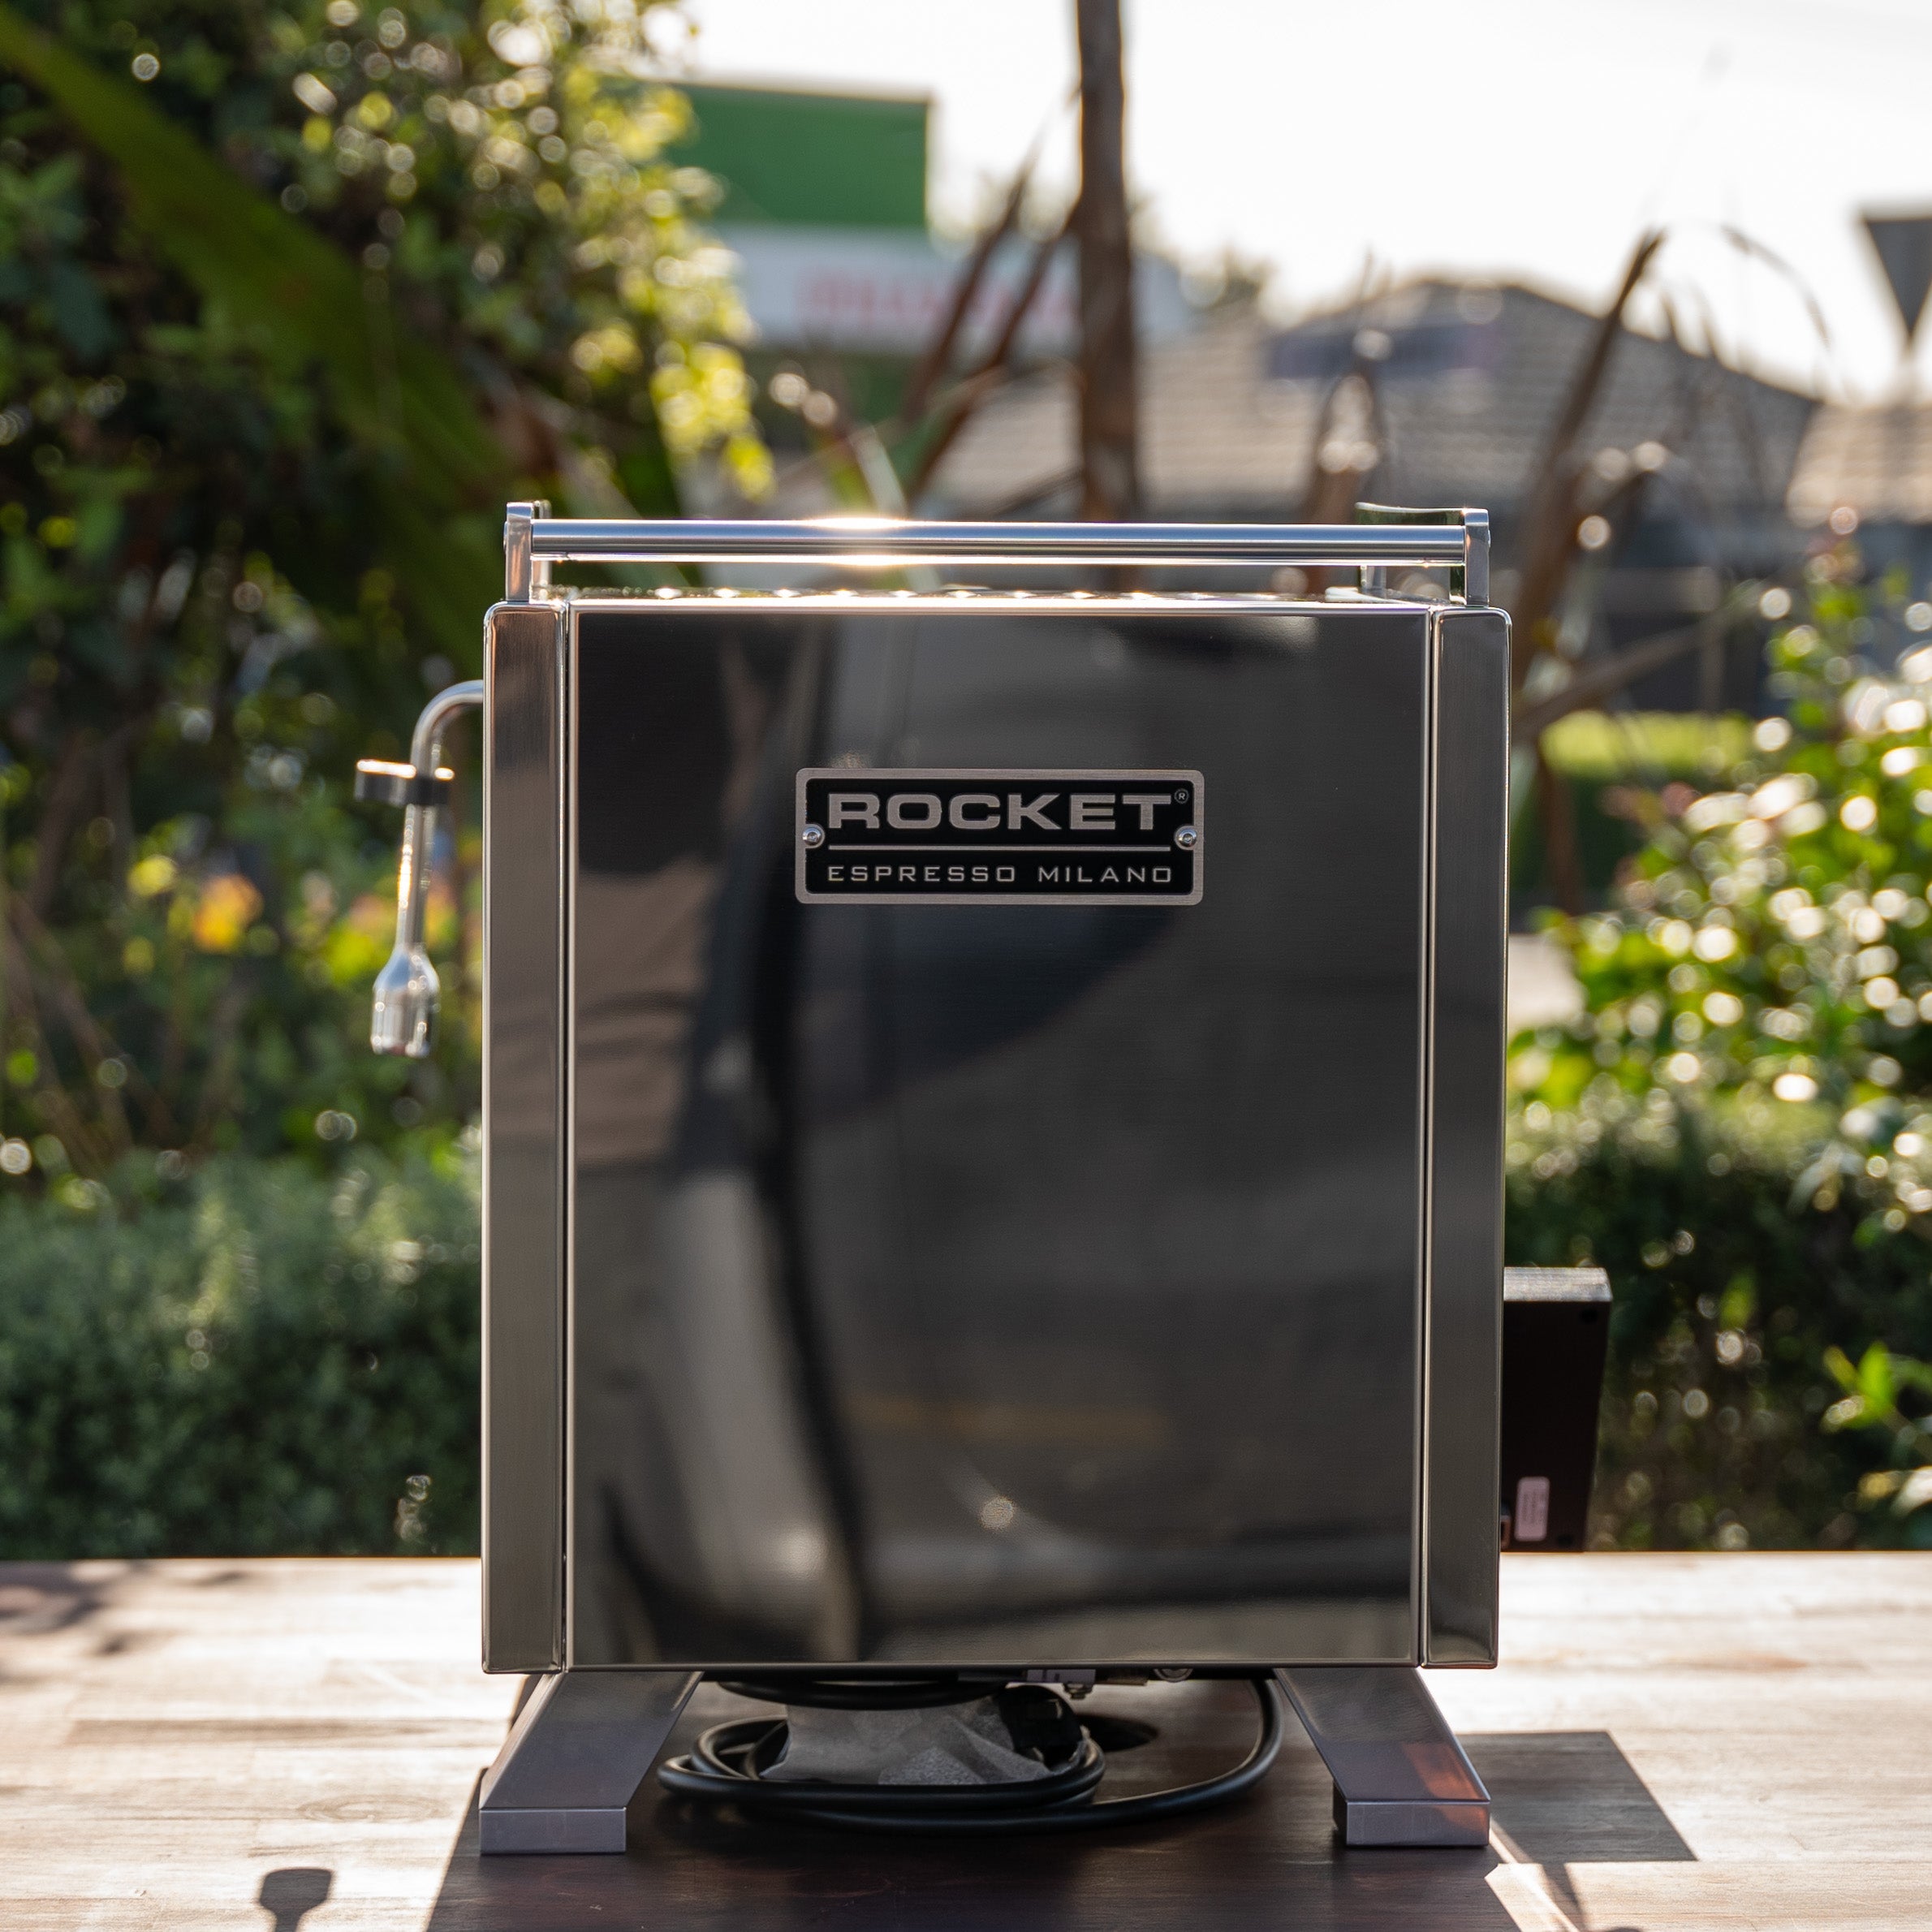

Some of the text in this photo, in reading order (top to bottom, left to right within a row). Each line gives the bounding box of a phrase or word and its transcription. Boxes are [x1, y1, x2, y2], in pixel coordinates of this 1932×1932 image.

[829, 793, 1171, 830] ROCKET
[828, 866, 1171, 883] ESPRESSO MILANO
